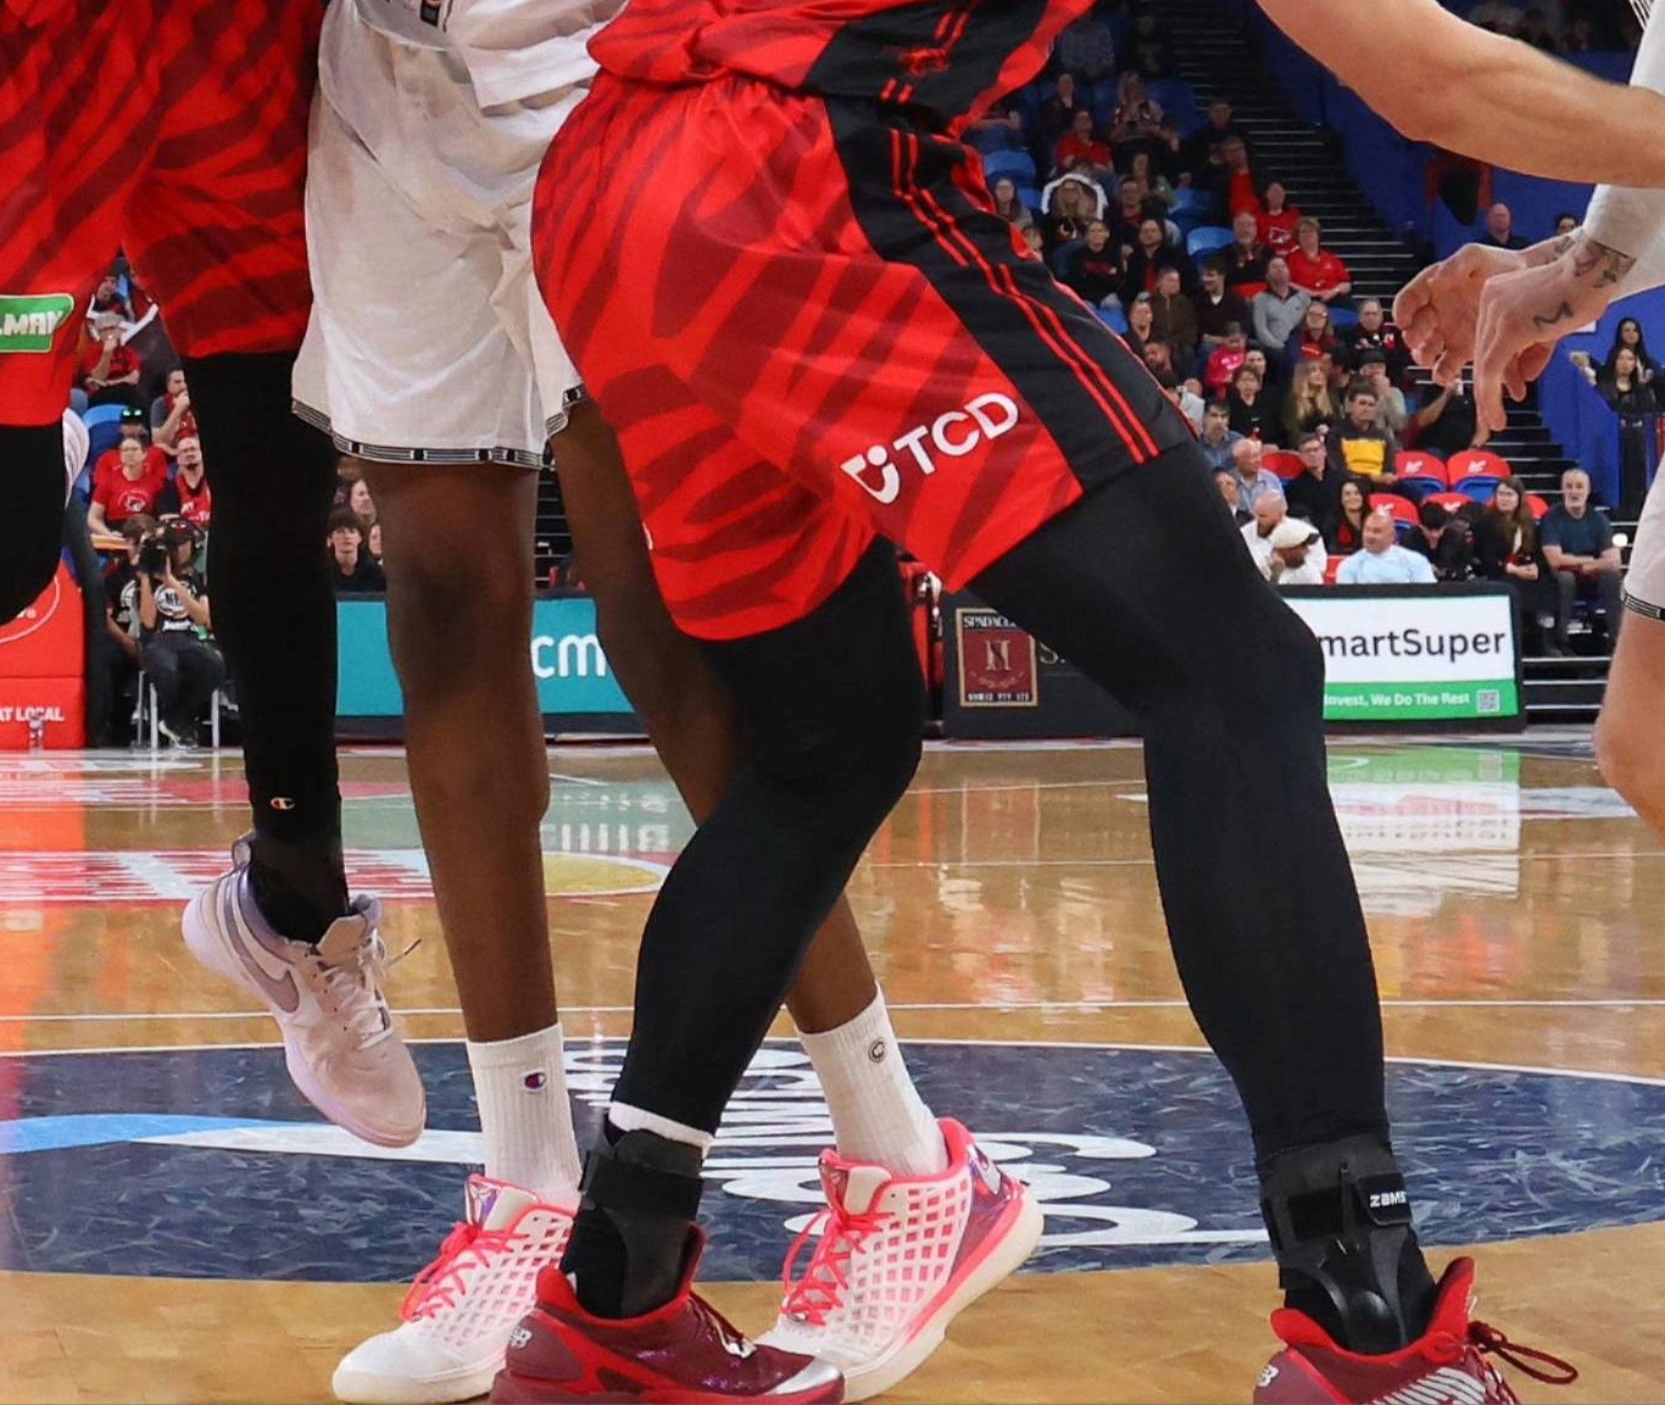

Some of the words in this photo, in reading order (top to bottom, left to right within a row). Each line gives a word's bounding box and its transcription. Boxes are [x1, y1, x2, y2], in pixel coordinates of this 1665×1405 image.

[893, 392, 1019, 475] TCD
[1319, 628, 1505, 659] martSuper
[1371, 693, 1392, 706] We
[1394, 693, 1412, 706] Do
[1414, 692, 1438, 705] The
[1440, 692, 1470, 704] Rest
[15, 707, 65, 723] LOCAL
